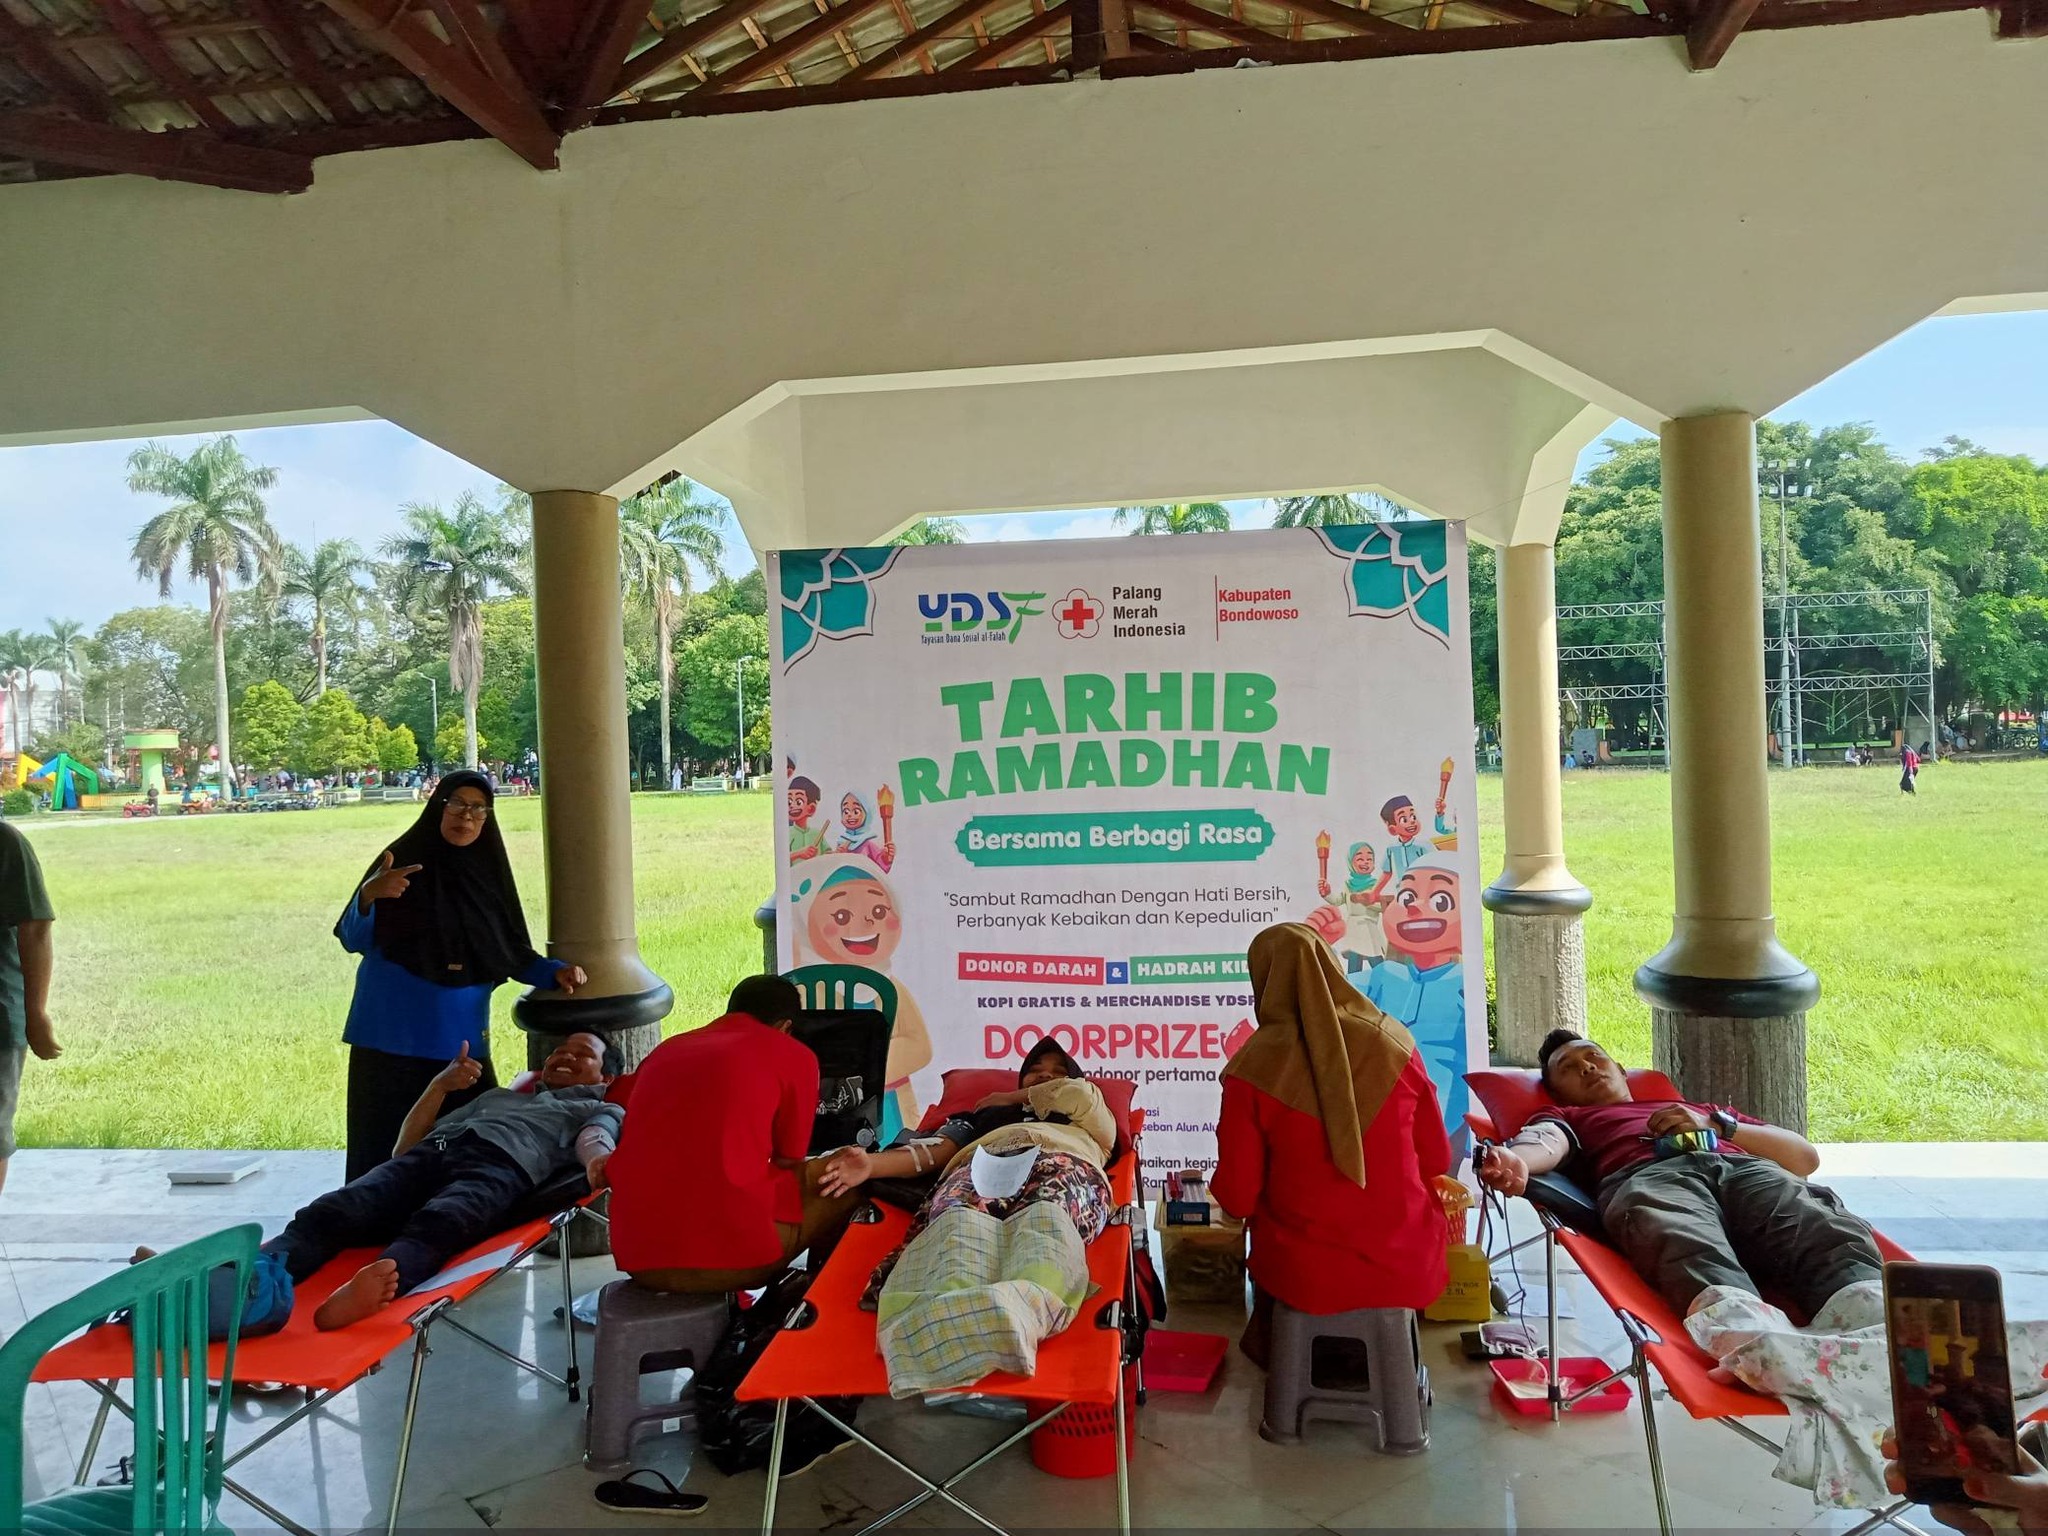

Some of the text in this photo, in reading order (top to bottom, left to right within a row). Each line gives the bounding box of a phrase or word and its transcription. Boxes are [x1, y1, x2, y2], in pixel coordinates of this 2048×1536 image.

[1112, 586, 1162, 601] Palang
[1218, 588, 1291, 603] Kabupaten
[1113, 605, 1158, 620] Merah
[1219, 608, 1299, 622] Bondowoso
[1113, 623, 1186, 638] Indonesia
[940, 672, 1279, 743] TARHIB
[897, 739, 1331, 807] RAMADHAN
[967, 821, 1263, 852] Bersama Berbagi Rasa
[944, 886, 1291, 907] "Sambut Ramadhan Dengan Hati Bersih,
[957, 907, 1279, 931] Perbanyak Kebaikan dan Kepedulian"
[965, 959, 1027, 974] DONOR
[1032, 962, 1097, 977] DARAH
[1111, 967, 1122, 978] &
[1137, 961, 1216, 976] HADRAH
[977, 997, 1013, 1008] KOPI
[1017, 996, 1076, 1008] GRATIS
[1080, 997, 1091, 1007] &
[1096, 995, 1211, 1007] MERCHANDISE
[984, 1023, 1221, 1060] DOORPRIZE
[1145, 1067, 1217, 1084] pertama
[1175, 1122, 1199, 1132] Alun
